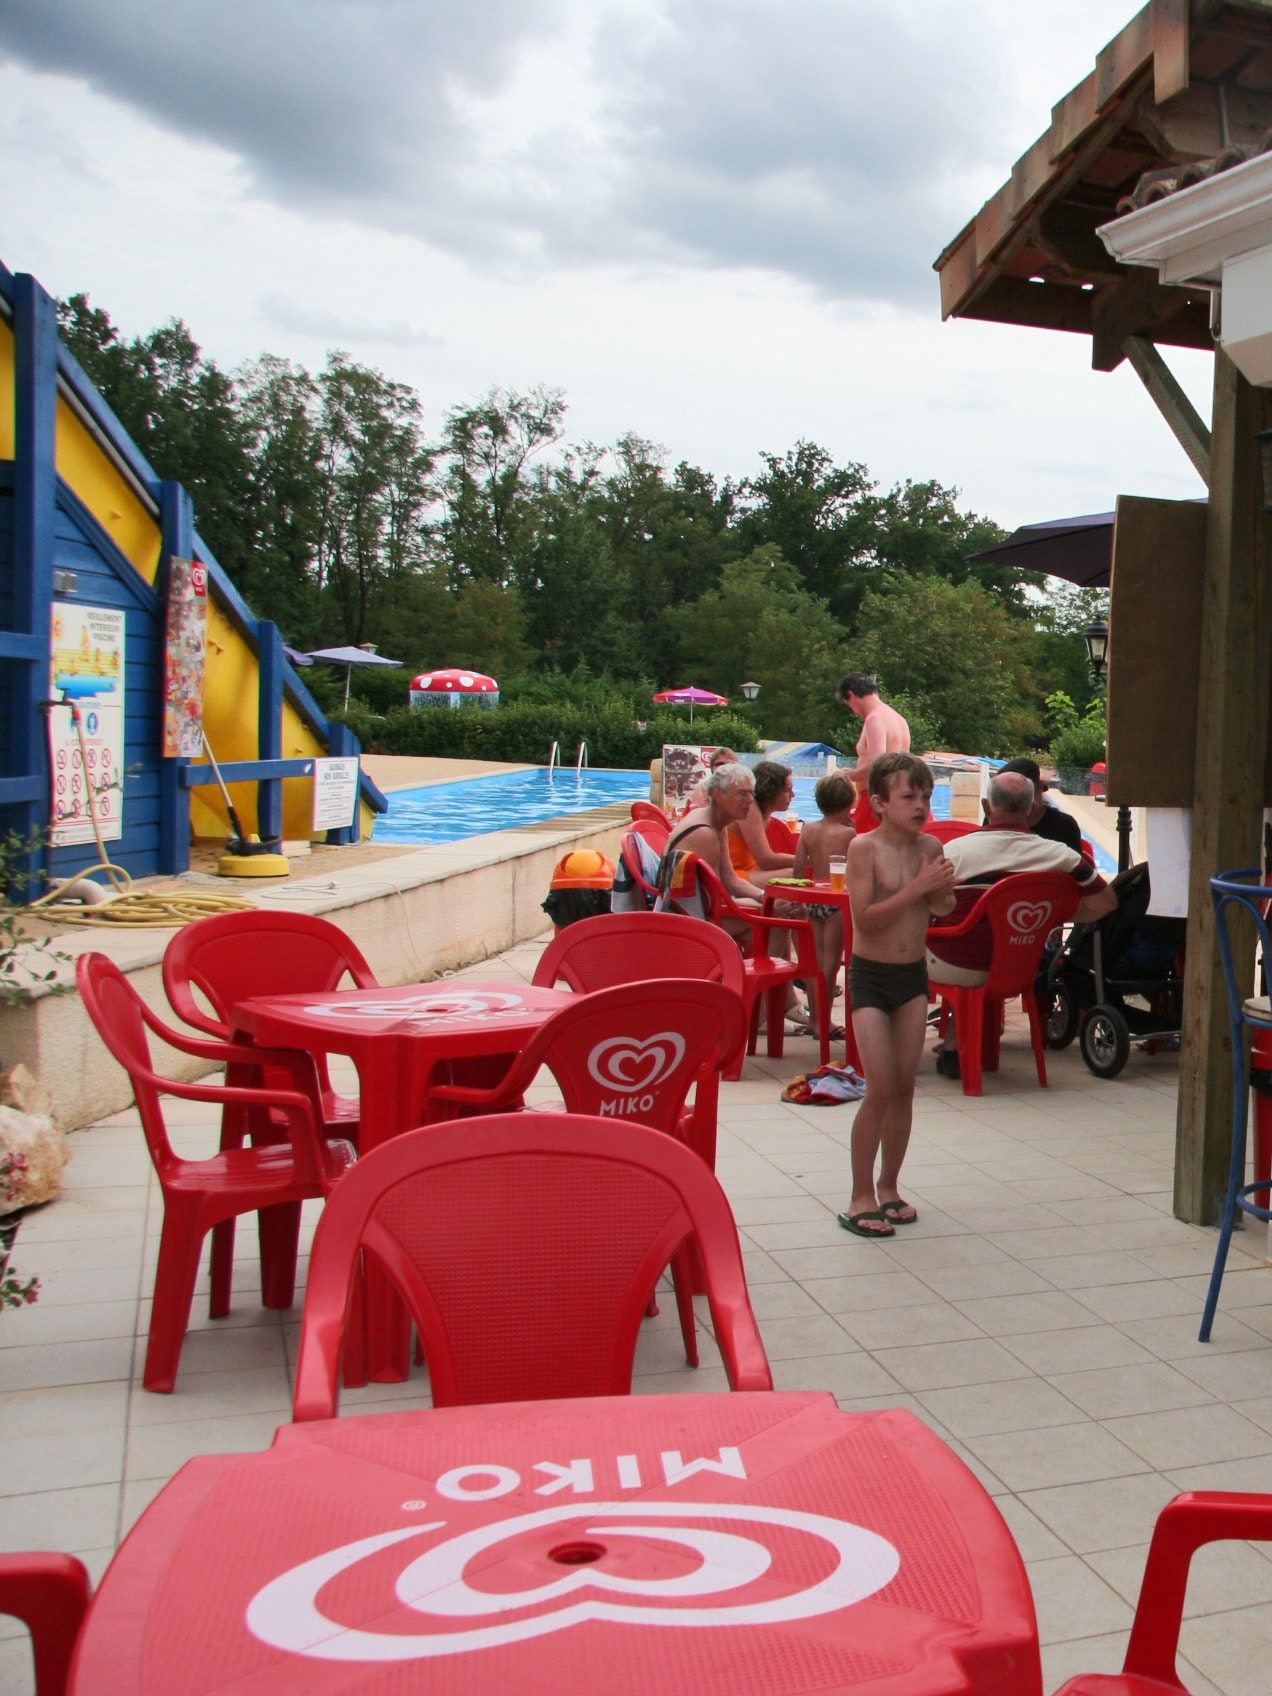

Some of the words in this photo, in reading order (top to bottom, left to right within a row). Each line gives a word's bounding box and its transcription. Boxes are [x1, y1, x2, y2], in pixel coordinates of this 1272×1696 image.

[1009, 935, 1036, 945] MIKO
[599, 1094, 654, 1117] MIKO
[435, 1446, 747, 1501] MIKO
